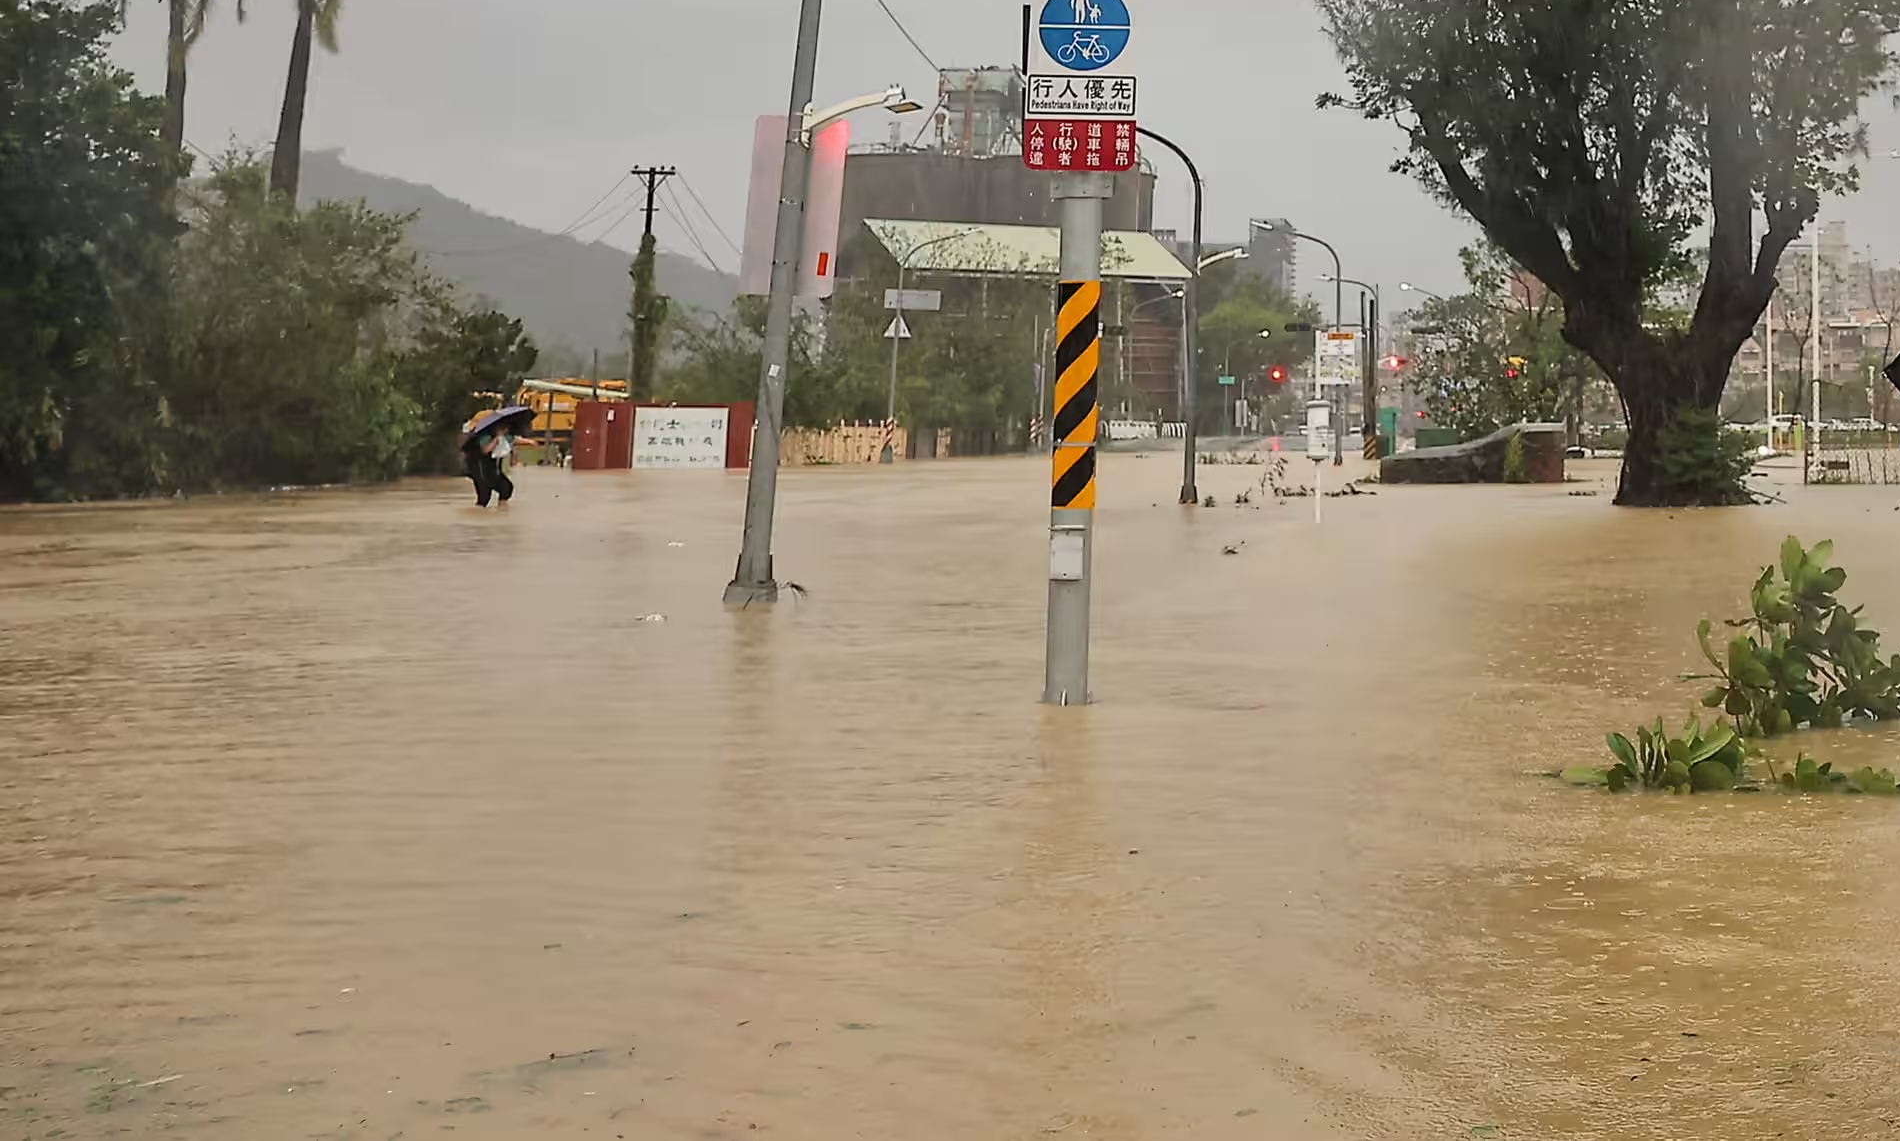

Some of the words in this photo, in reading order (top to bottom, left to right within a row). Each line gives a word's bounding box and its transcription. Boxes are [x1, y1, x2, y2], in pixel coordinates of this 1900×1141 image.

[1032, 78, 1131, 99] 行人優先
[1031, 99, 1072, 110] Pedestrians
[1073, 100, 1089, 110] Have
[1090, 101, 1108, 111] Right
[1108, 101, 1117, 110] of
[1117, 102, 1130, 112] Way
[1030, 122, 1131, 138] 人行道禁
[1030, 136, 1130, 152] 停(駛)車輛
[1029, 150, 1129, 166] 違者拖吊
